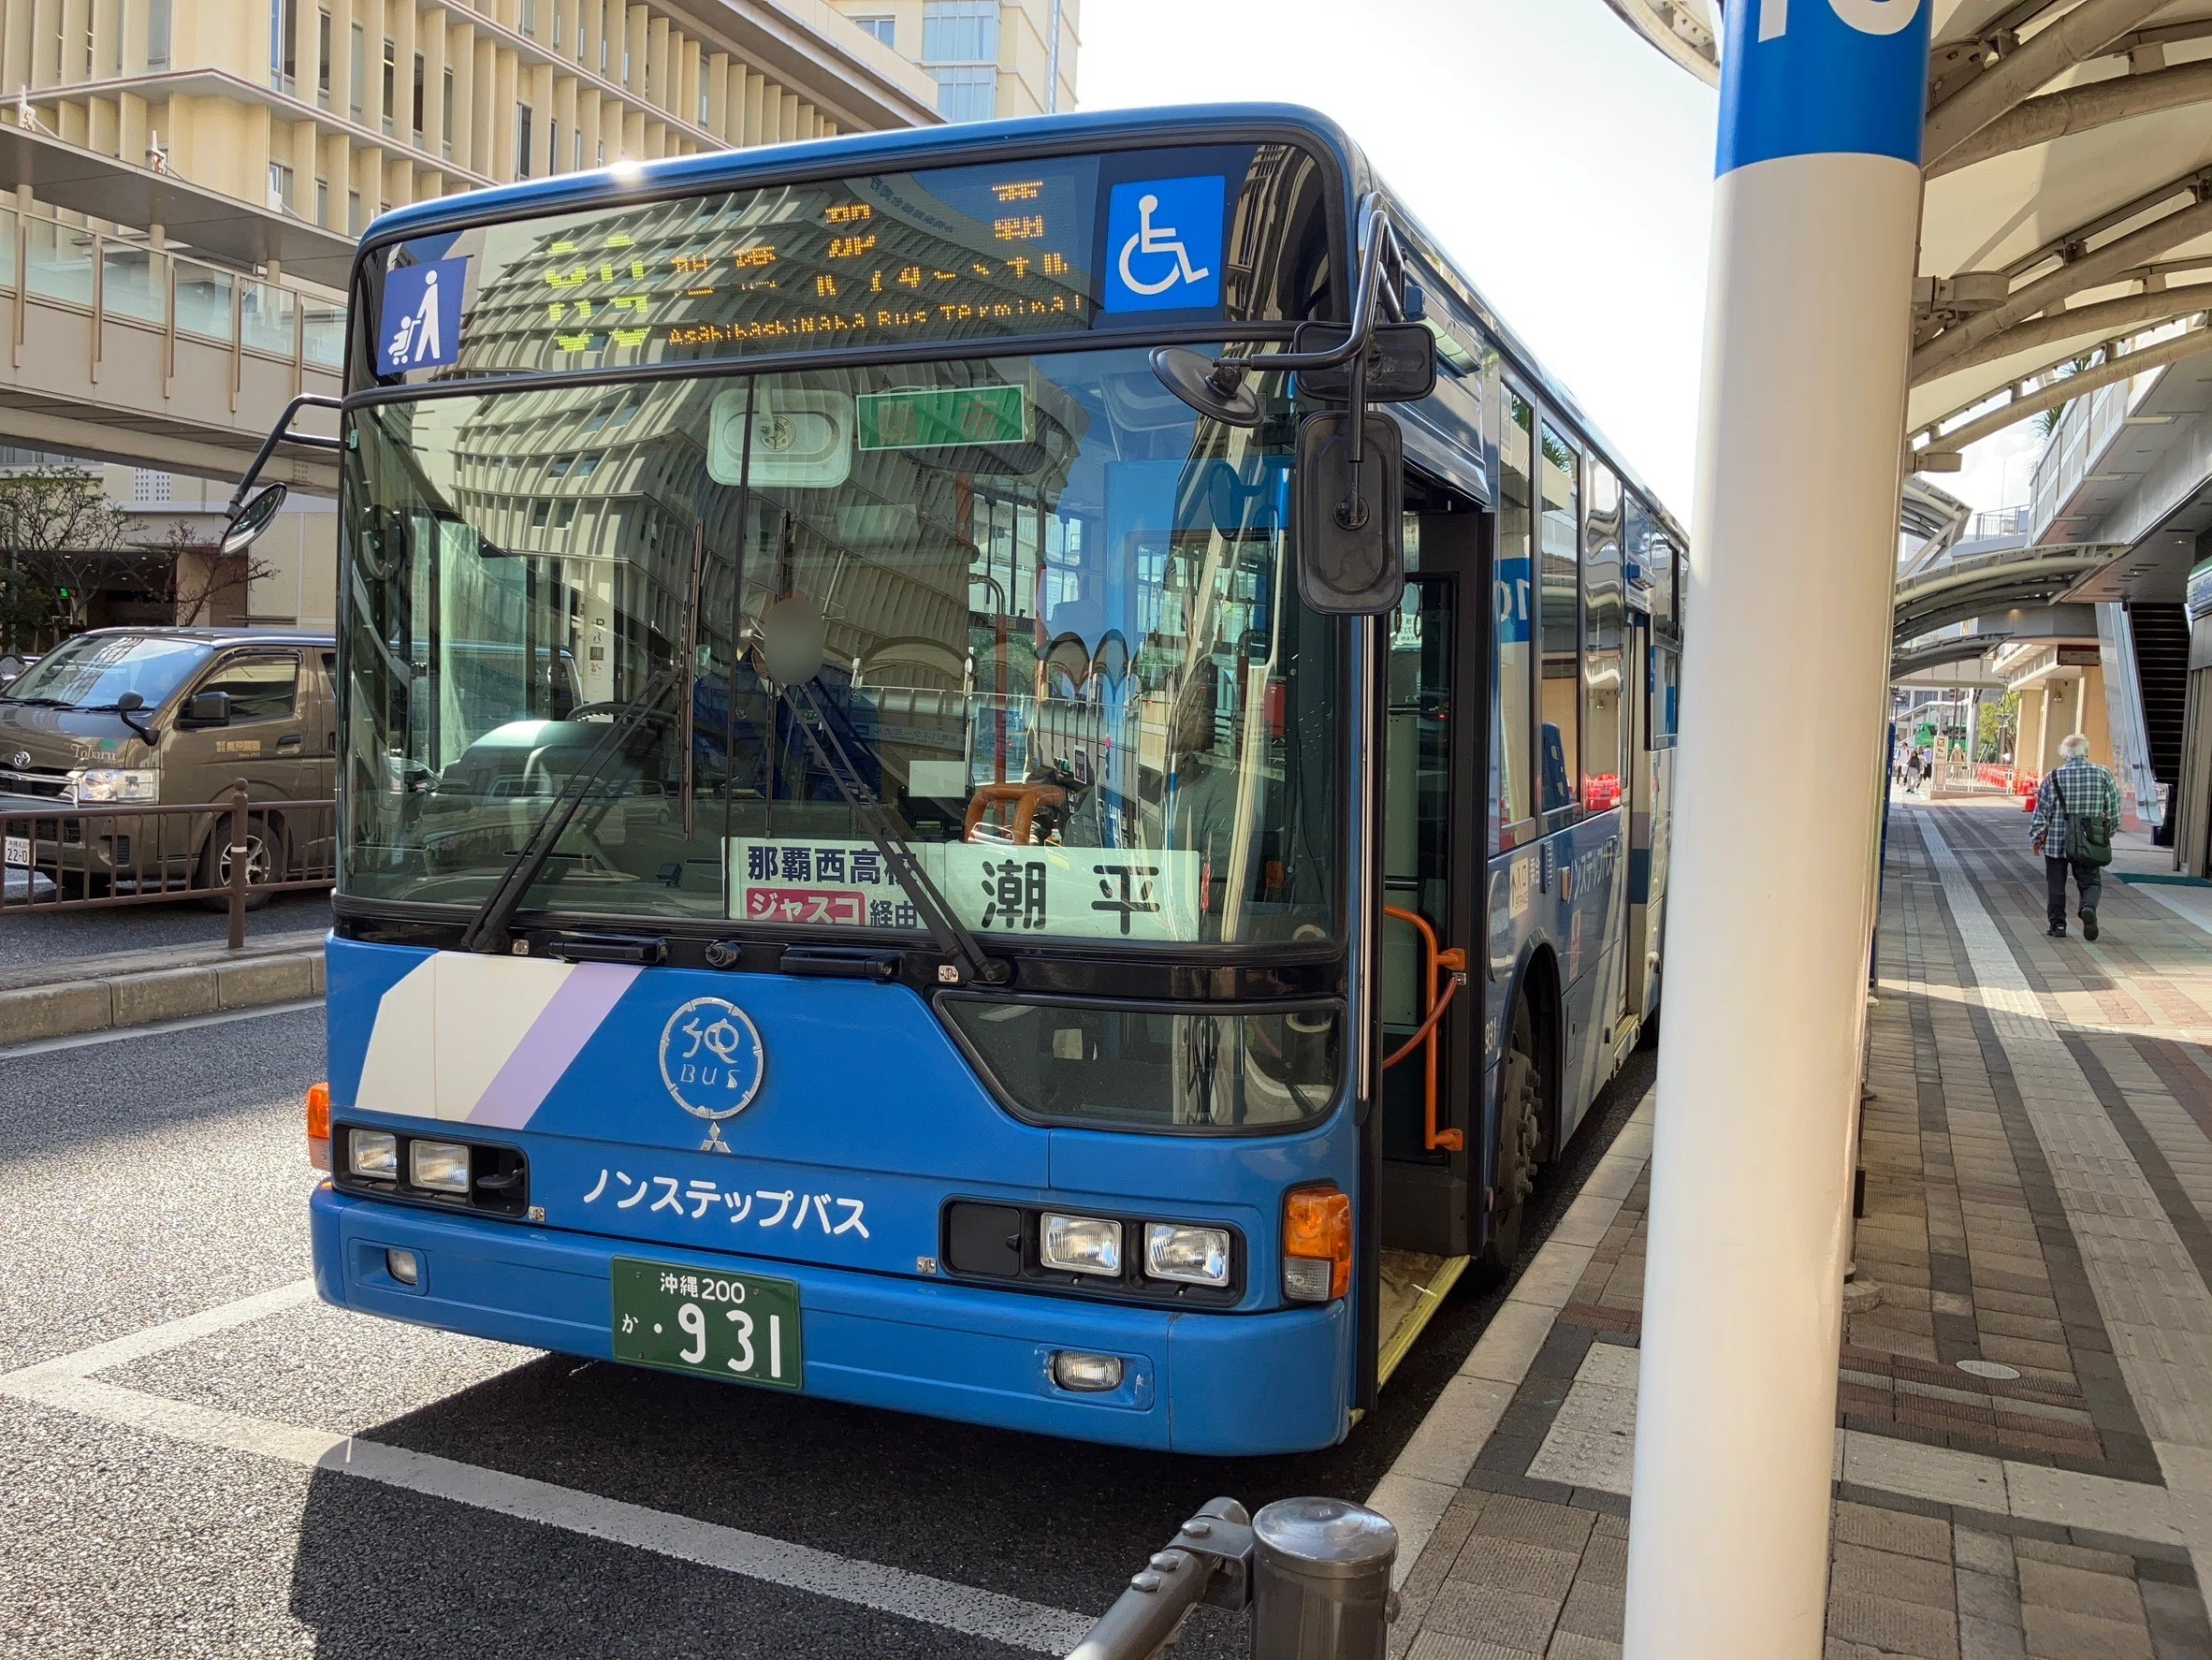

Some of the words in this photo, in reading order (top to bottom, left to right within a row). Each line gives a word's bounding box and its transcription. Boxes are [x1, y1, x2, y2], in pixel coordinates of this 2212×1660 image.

[70, 743, 117, 761] Tobaru
[749, 890, 862, 924] ジャスコ
[981, 858, 1160, 936] 潮平
[1485, 1016, 1496, 1055] 931
[680, 1063, 742, 1089] BUS
[583, 1169, 870, 1239] ノンステップバス
[660, 1272, 746, 1305] 沖縄200
[621, 1313, 638, 1334] か
